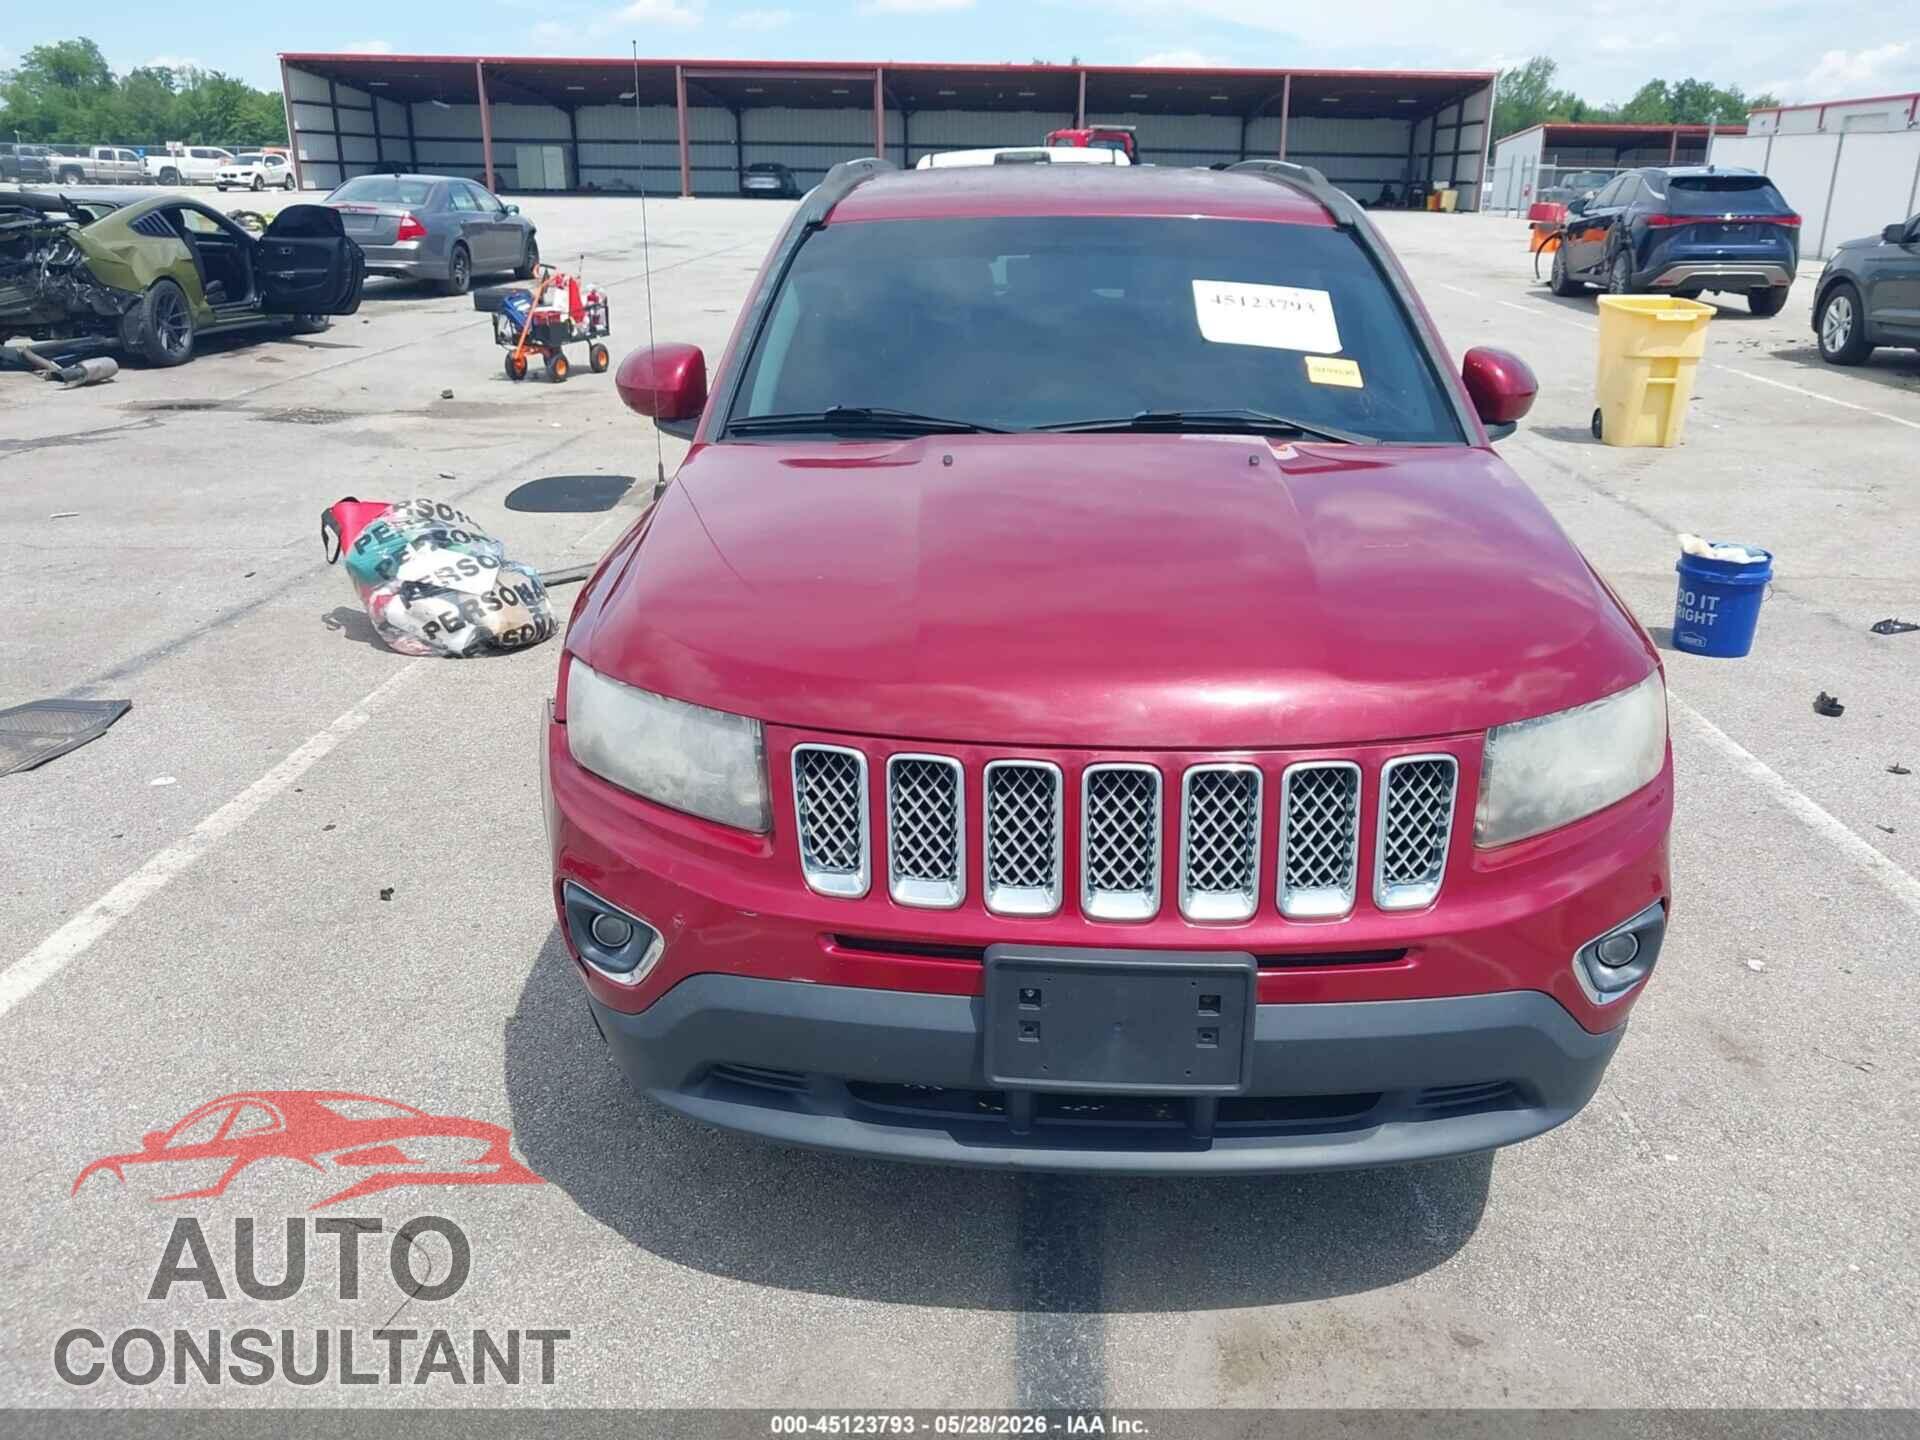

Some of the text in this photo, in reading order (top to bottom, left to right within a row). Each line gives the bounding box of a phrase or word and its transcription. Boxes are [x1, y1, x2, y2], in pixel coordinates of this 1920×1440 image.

[1679, 588, 1720, 610] DO IT
[1676, 606, 1718, 625] RIGHT
